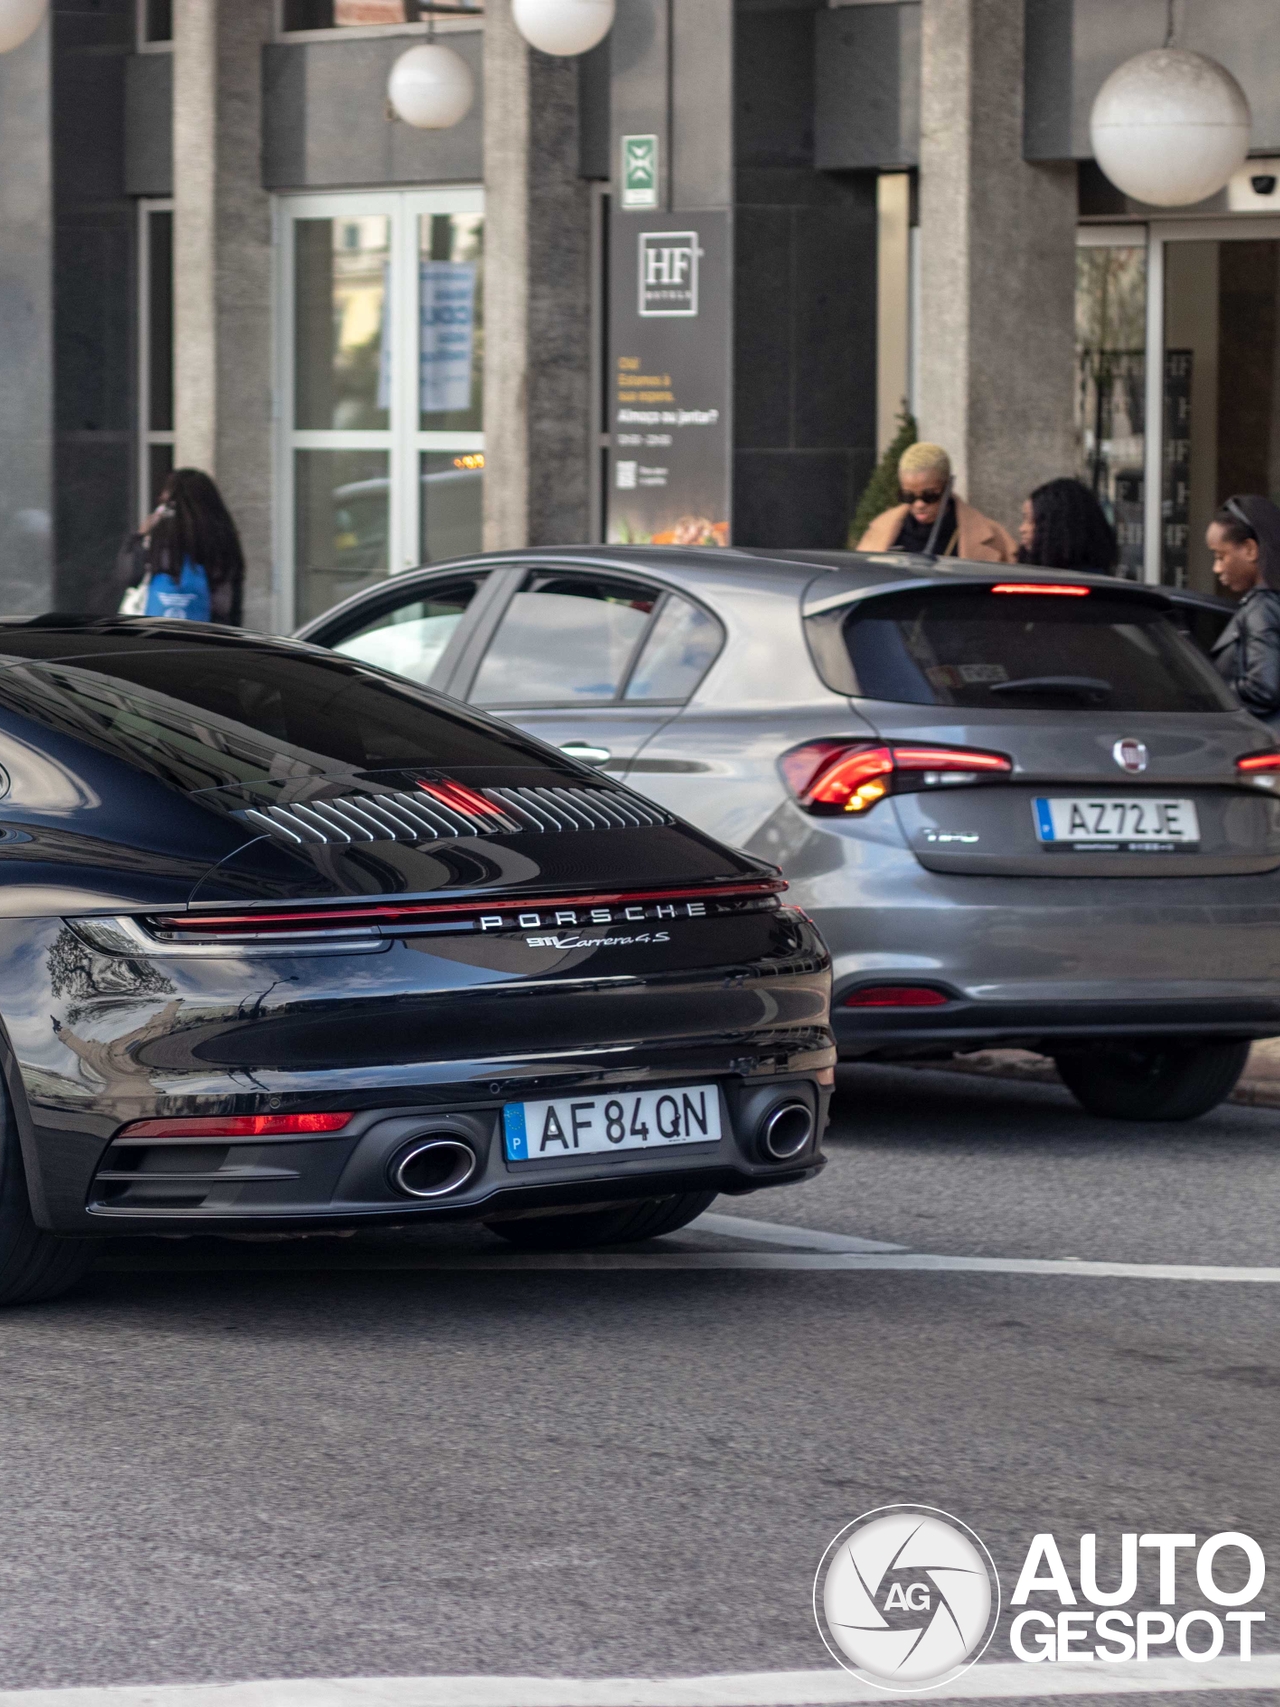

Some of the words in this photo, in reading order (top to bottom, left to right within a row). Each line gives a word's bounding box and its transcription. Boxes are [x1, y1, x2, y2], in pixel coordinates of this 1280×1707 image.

[645, 247, 692, 284] HF
[480, 902, 707, 930] PORSCHE
[513, 1137, 521, 1150] P
